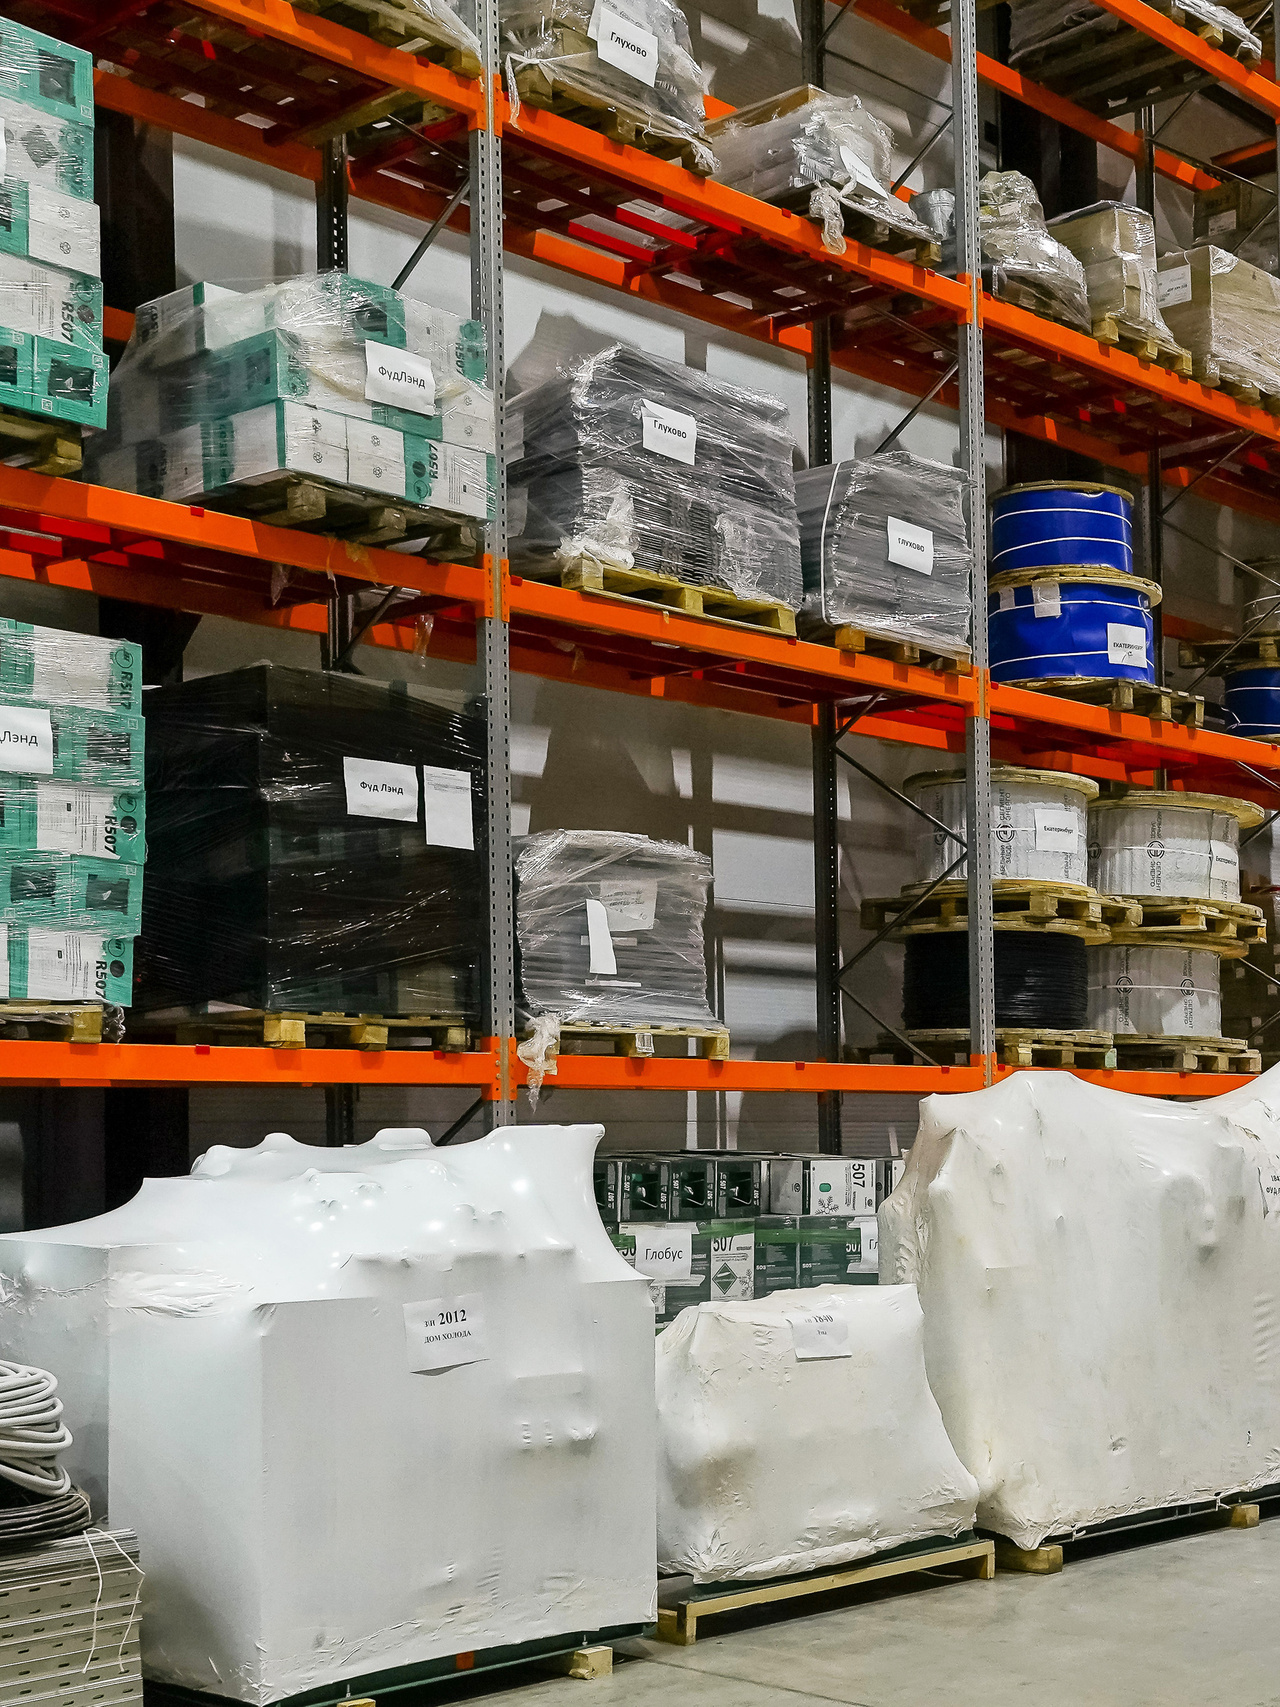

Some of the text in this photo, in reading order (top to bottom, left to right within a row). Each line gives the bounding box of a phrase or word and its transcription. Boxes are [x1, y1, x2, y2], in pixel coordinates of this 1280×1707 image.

[610, 31, 647, 58] Глухово
[378, 366, 426, 389] ФудЛэнд
[653, 419, 687, 439] Глухово
[428, 443, 439, 480] R507
[0, 730, 39, 747] Лэнд
[359, 781, 404, 795] Фуд Лэнд
[104, 815, 118, 855] R507
[95, 960, 108, 1000] R507
[852, 1163, 865, 1188] 507
[713, 1236, 735, 1252] 507
[645, 1247, 683, 1262] Глобус
[438, 1309, 467, 1325] 2012
[424, 1330, 472, 1344] ДОМ ХОЛОДА
